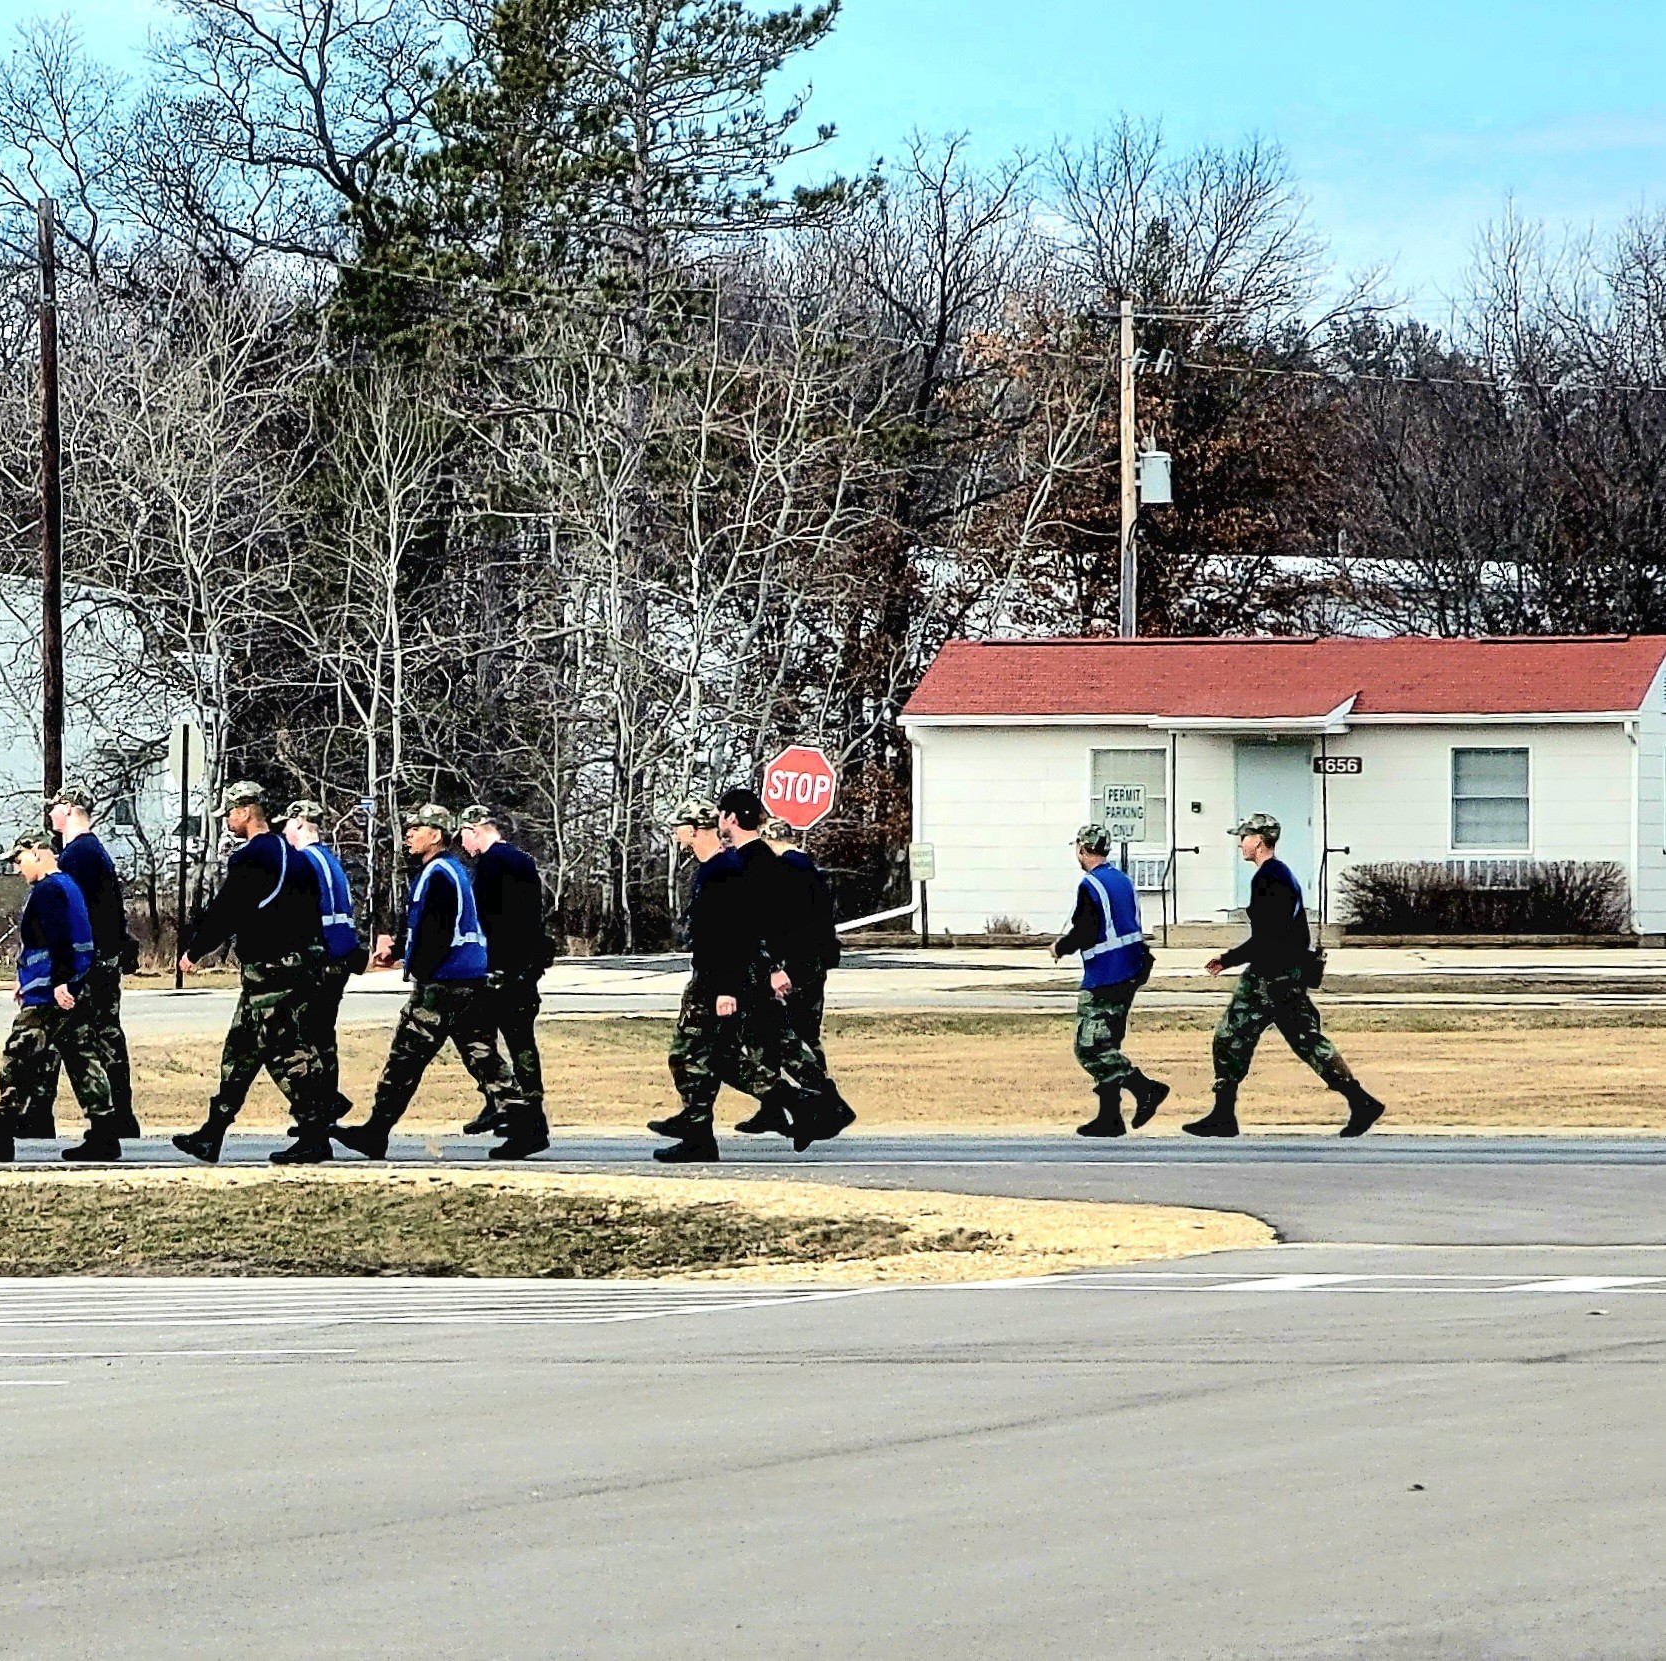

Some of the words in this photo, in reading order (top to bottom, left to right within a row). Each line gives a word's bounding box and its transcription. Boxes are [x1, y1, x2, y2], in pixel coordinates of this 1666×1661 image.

[1318, 758, 1359, 773] 1656
[767, 769, 831, 805] STOP
[1108, 788, 1141, 802] PERMIT
[1105, 806, 1144, 820] PARKING
[1111, 824, 1135, 838] ONLY
